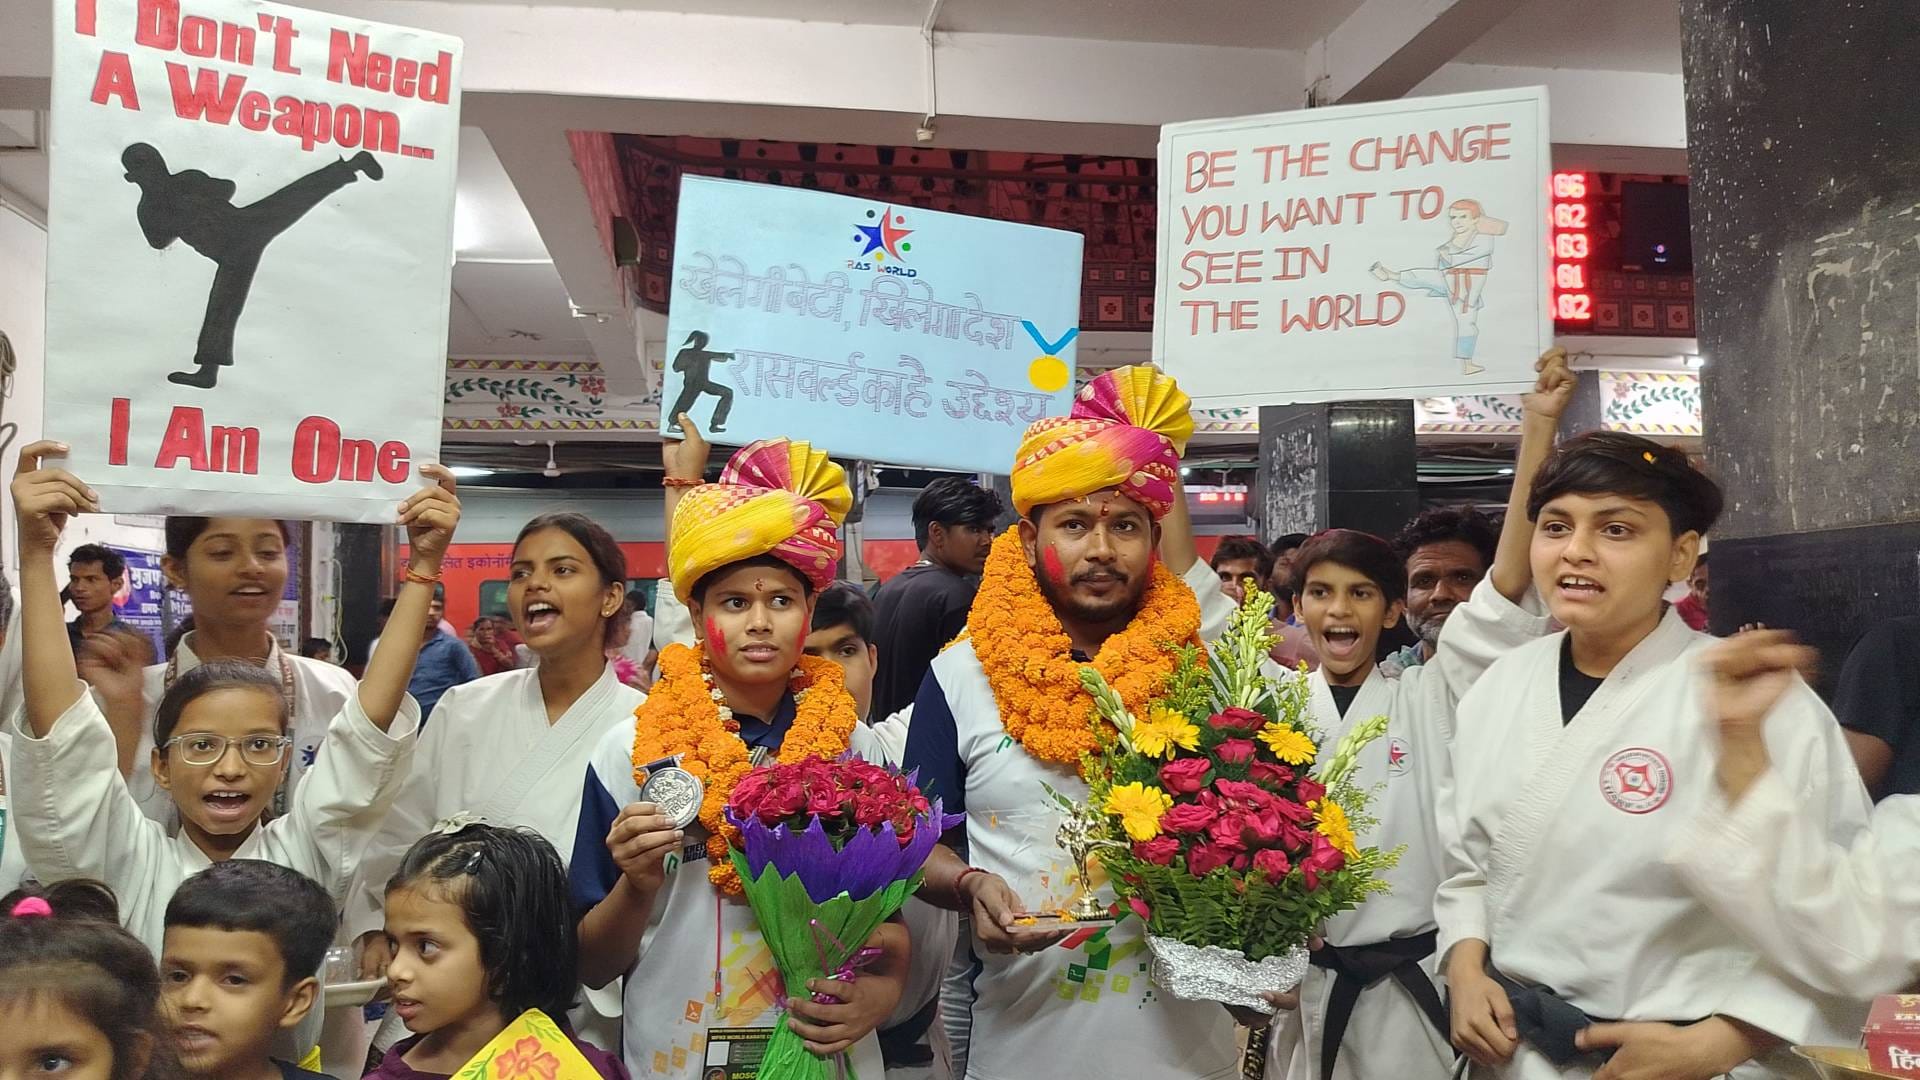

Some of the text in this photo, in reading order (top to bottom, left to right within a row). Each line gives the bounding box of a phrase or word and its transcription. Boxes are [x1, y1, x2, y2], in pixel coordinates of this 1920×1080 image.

[75, 0, 453, 104] I Don't Need
[90, 50, 141, 111] A
[1185, 123, 1511, 194] BE THE CHANGE
[1182, 185, 1444, 245] YOU WANT TO
[847, 260, 917, 278] RAS WORLD
[1178, 244, 1330, 291] SEE IN
[1181, 291, 1406, 336] THE WORLD
[109, 397, 411, 484] I Am One
